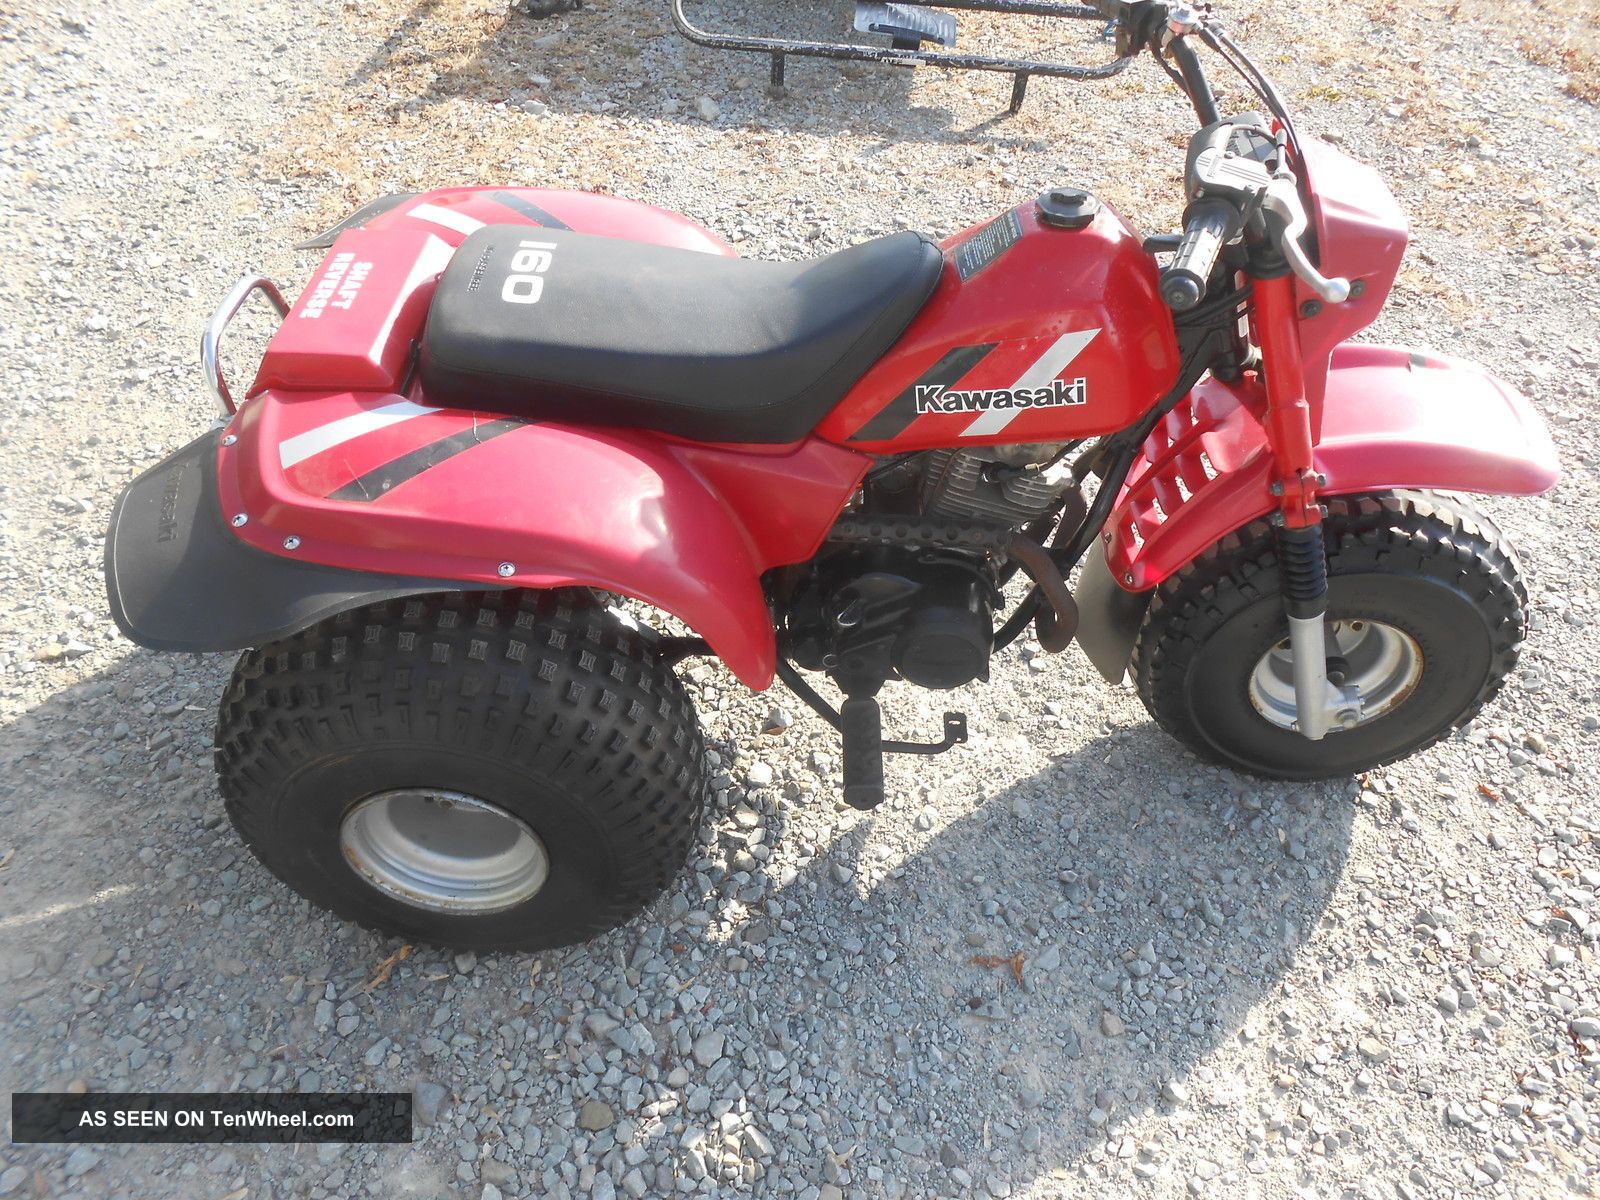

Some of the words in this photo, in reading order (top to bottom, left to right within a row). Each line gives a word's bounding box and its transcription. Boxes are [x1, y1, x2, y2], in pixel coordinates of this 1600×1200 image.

[299, 253, 356, 319] REVERSE
[331, 261, 373, 310] SHAFT
[501, 240, 557, 305] 160
[915, 377, 1087, 414] Kawasaki
